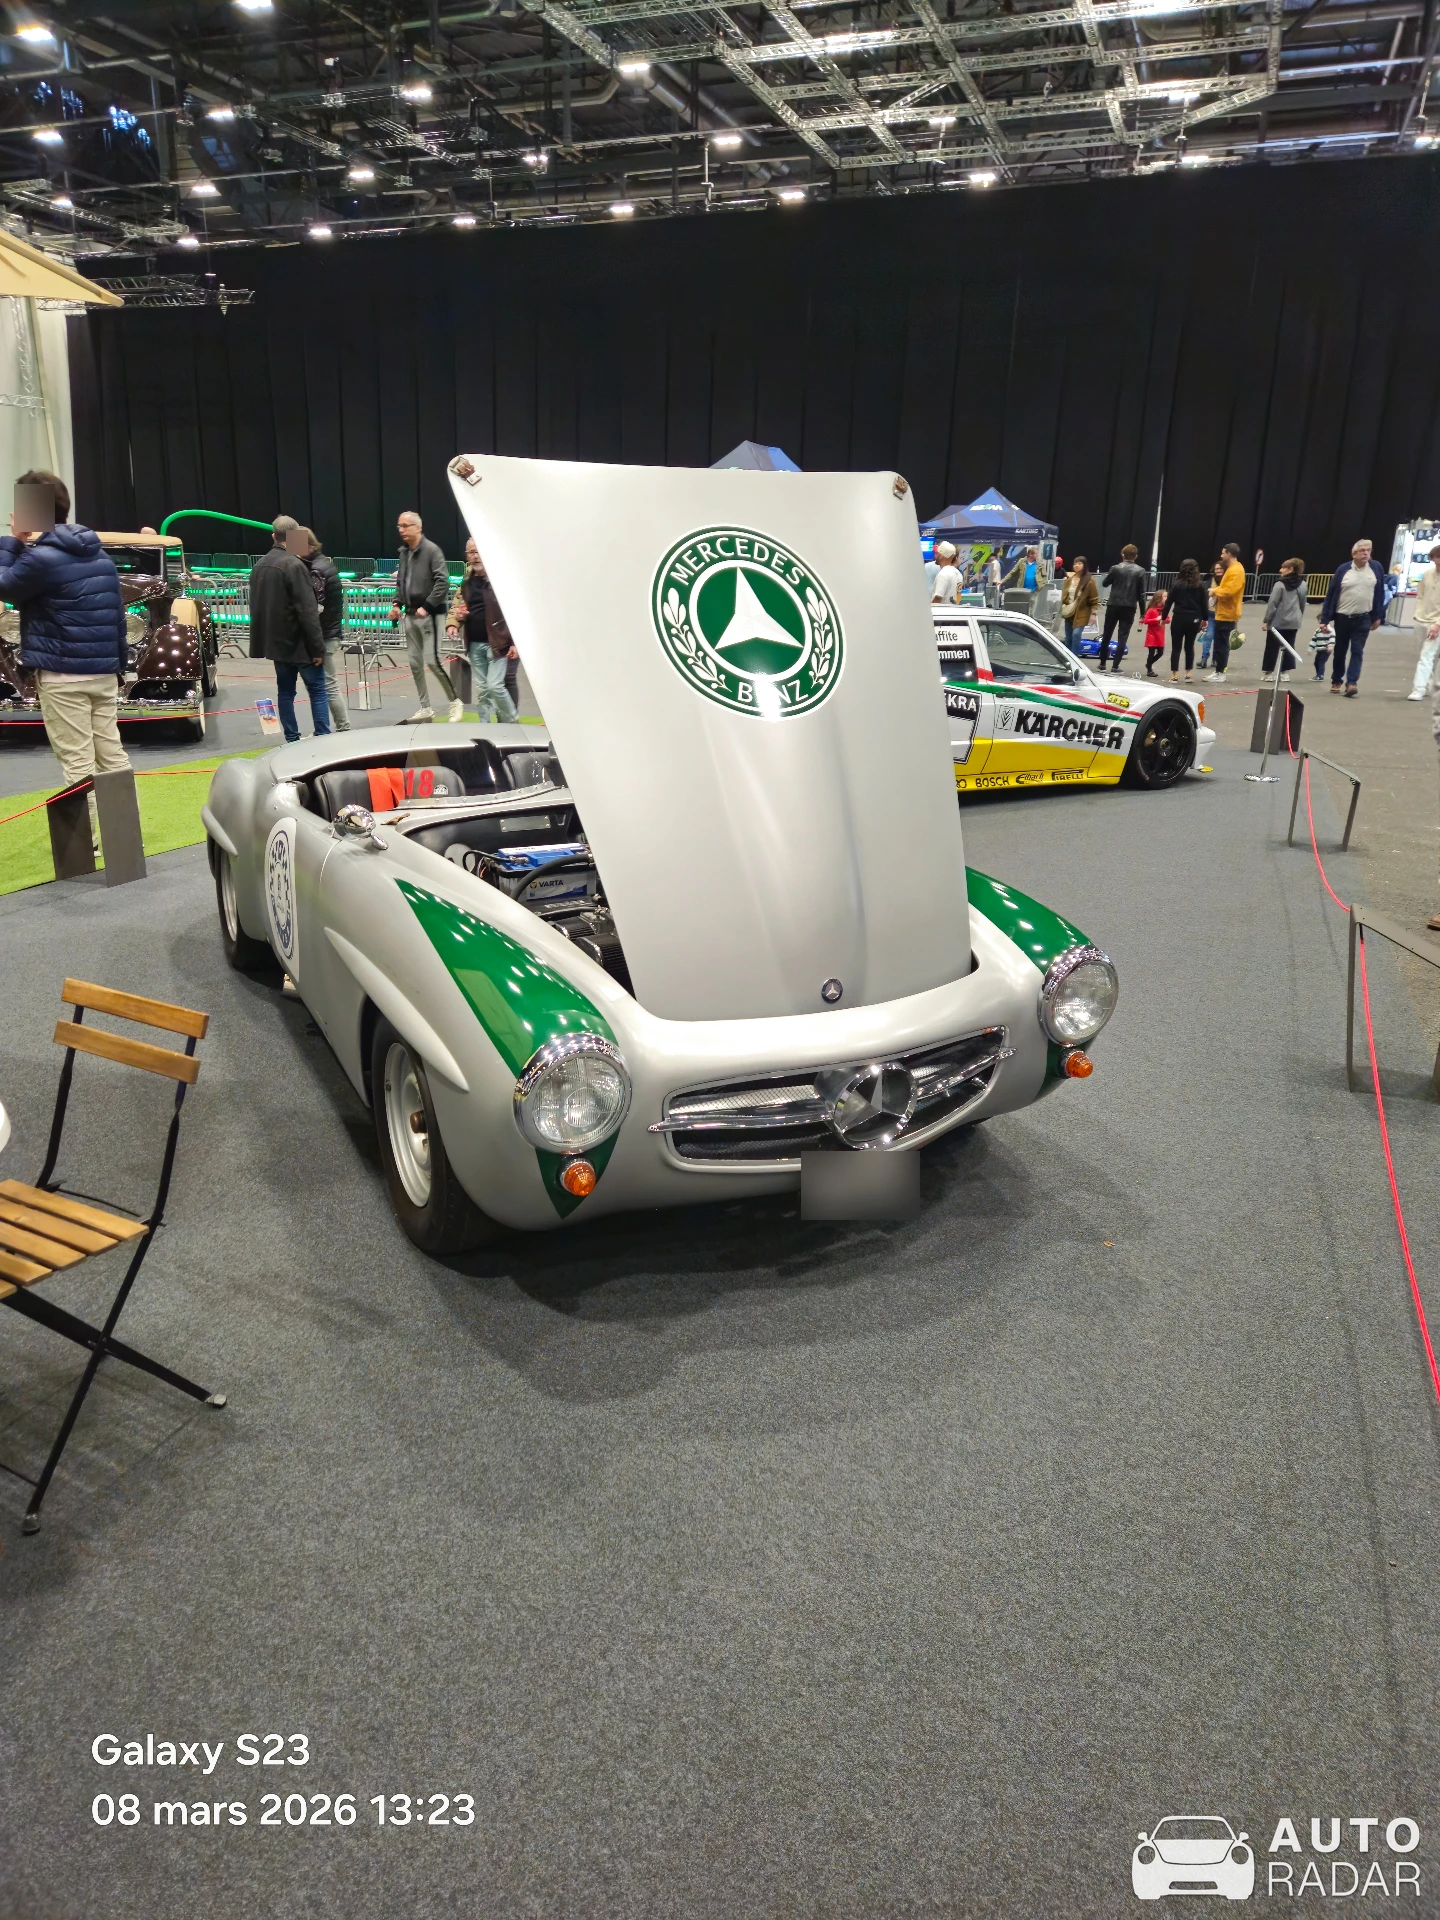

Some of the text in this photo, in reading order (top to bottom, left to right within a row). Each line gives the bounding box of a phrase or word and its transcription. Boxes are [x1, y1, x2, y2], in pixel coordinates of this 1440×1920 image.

[669, 536, 805, 586] MERCEDES
[935, 630, 958, 642] ffite
[938, 649, 970, 659] mmen
[737, 679, 809, 705] BNZ
[943, 692, 977, 712] KRA
[1013, 708, 1126, 750] KÄRCHER
[404, 768, 435, 798] 18
[975, 776, 1010, 788] BOSCH
[1051, 769, 1085, 781] PIRELLI
[538, 879, 564, 888] VARTA
